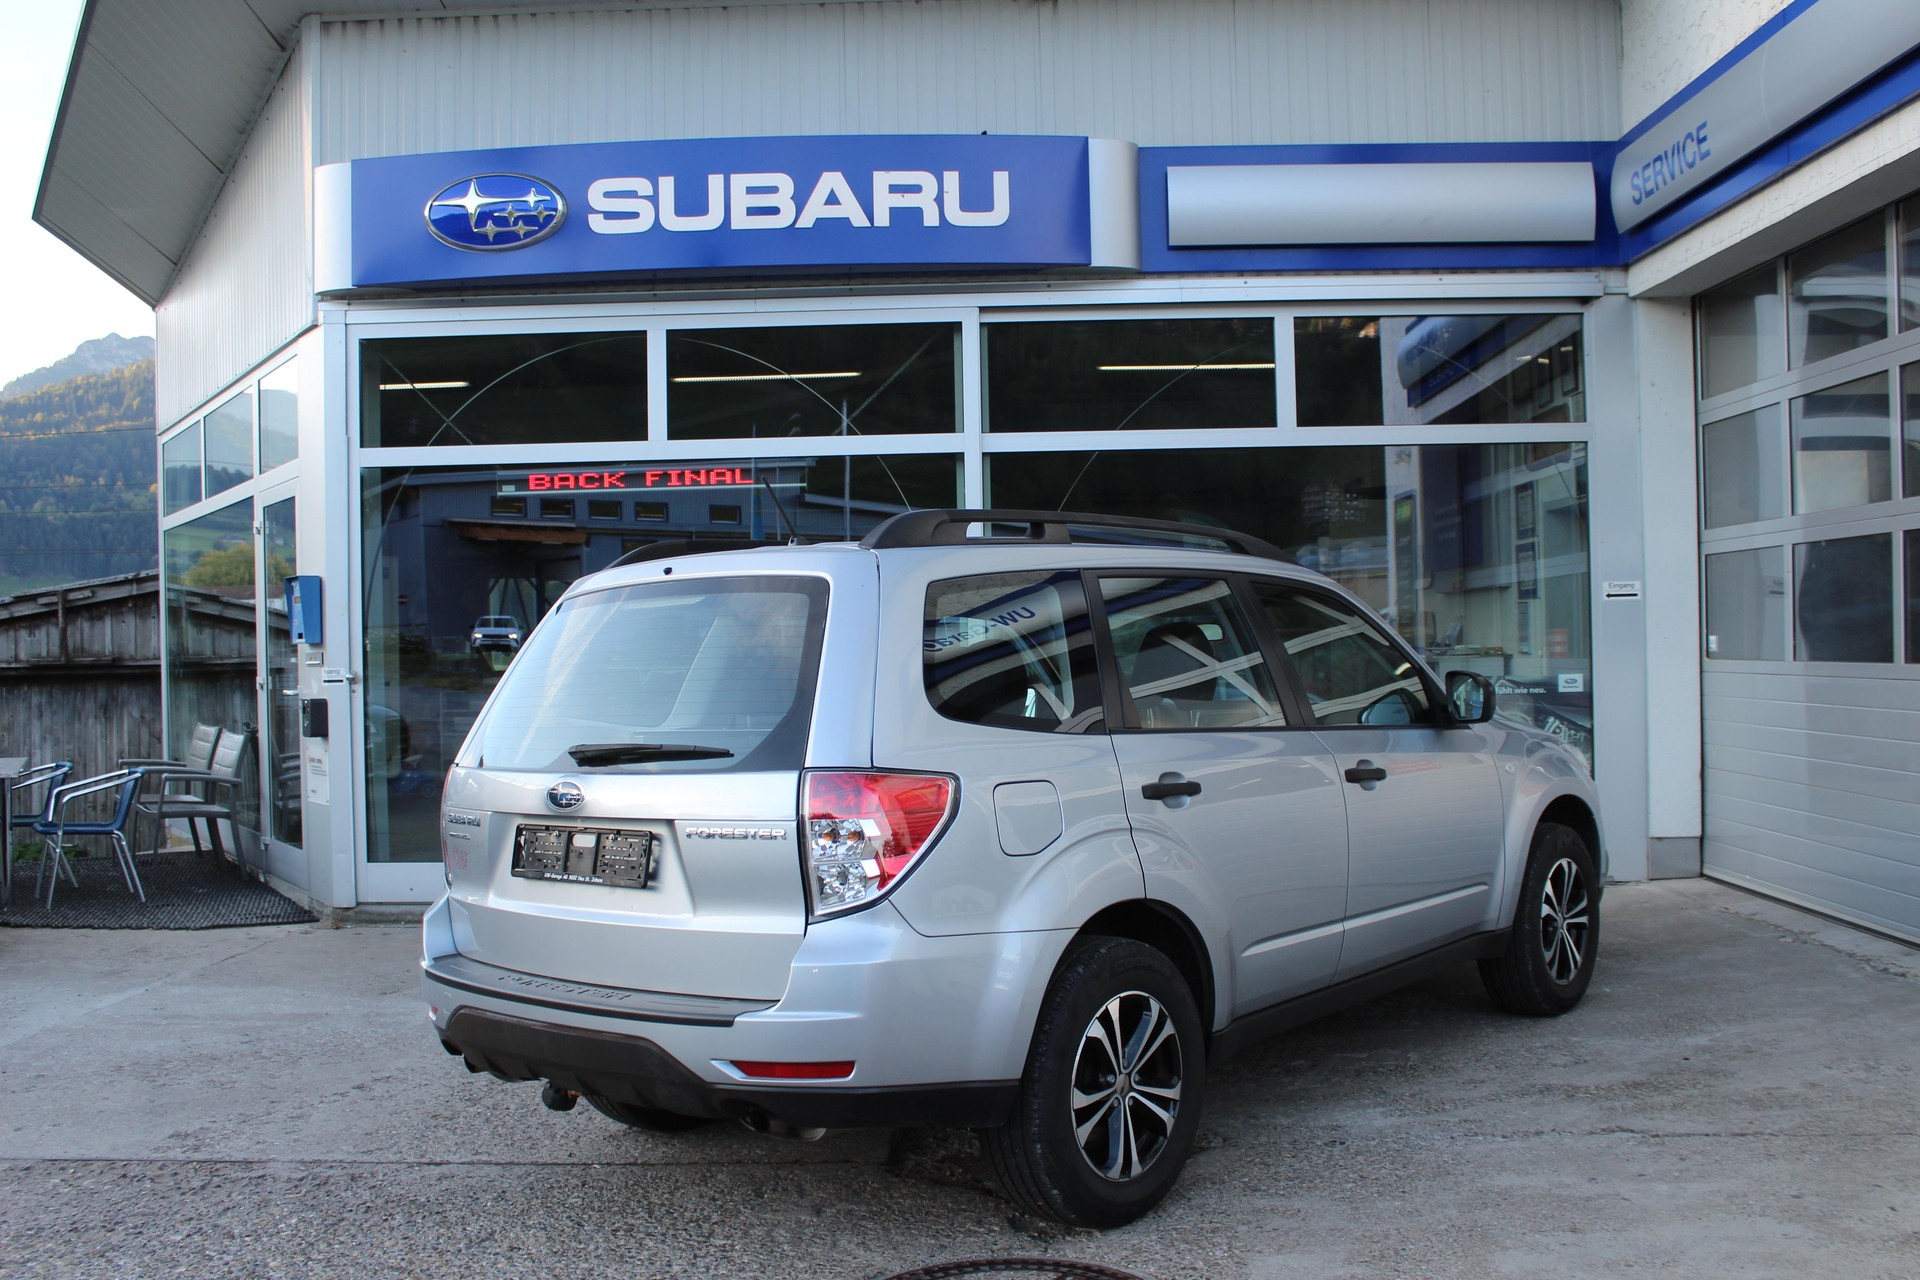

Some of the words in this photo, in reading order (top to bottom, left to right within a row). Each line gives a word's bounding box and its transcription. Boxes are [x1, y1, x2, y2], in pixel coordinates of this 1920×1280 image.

[1630, 120, 1712, 206] SERVICE
[587, 170, 1011, 235] SUBARU
[528, 471, 626, 490] BACK
[645, 468, 754, 487] FINAL
[1496, 686, 1514, 694] fühlt
[1514, 686, 1528, 694] wie
[685, 827, 787, 840] FORESTER
